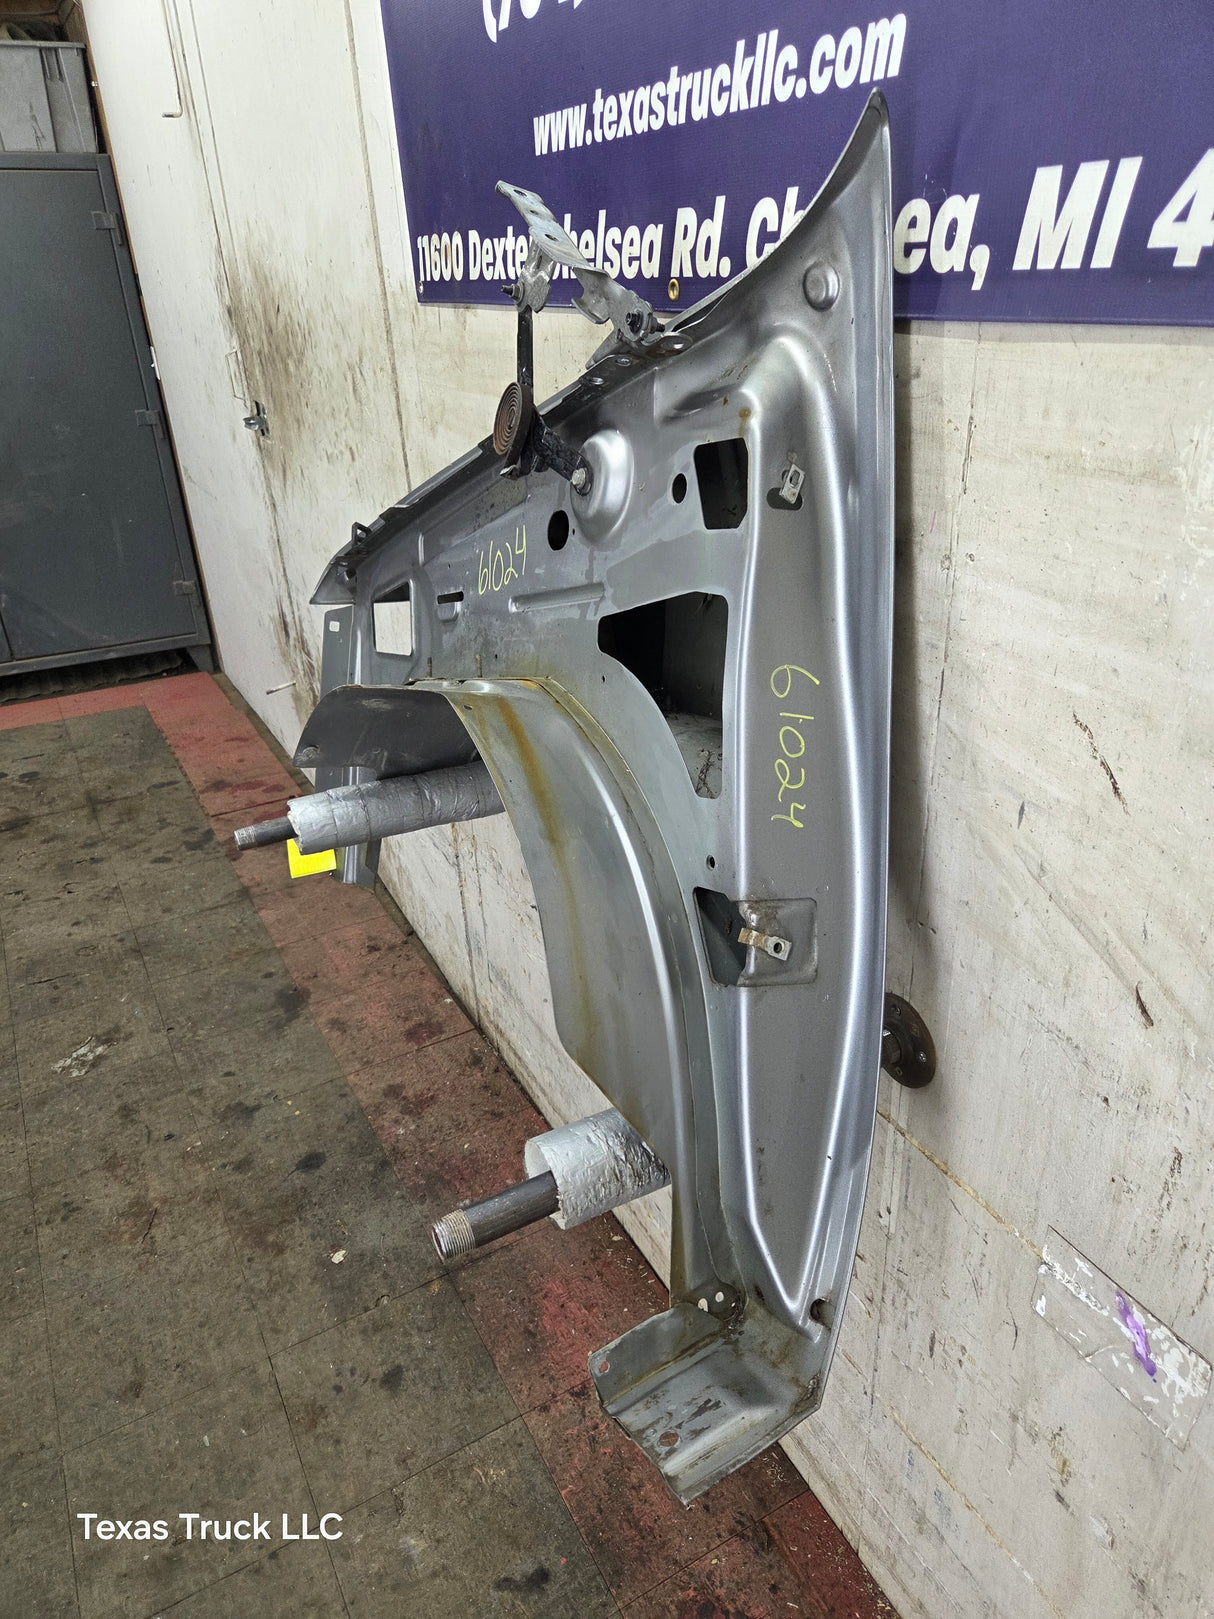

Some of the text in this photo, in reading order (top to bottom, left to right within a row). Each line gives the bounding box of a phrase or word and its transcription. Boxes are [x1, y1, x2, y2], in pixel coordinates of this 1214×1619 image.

[533, 13, 907, 156] www.texastruckllc.com
[417, 230, 463, 282] 11600
[468, 225, 533, 281] Dexte
[551, 209, 663, 280] helsea
[670, 195, 731, 278] Rd.
[1012, 156, 1143, 271] MI
[478, 524, 527, 595] 61024
[770, 664, 820, 828] 61024
